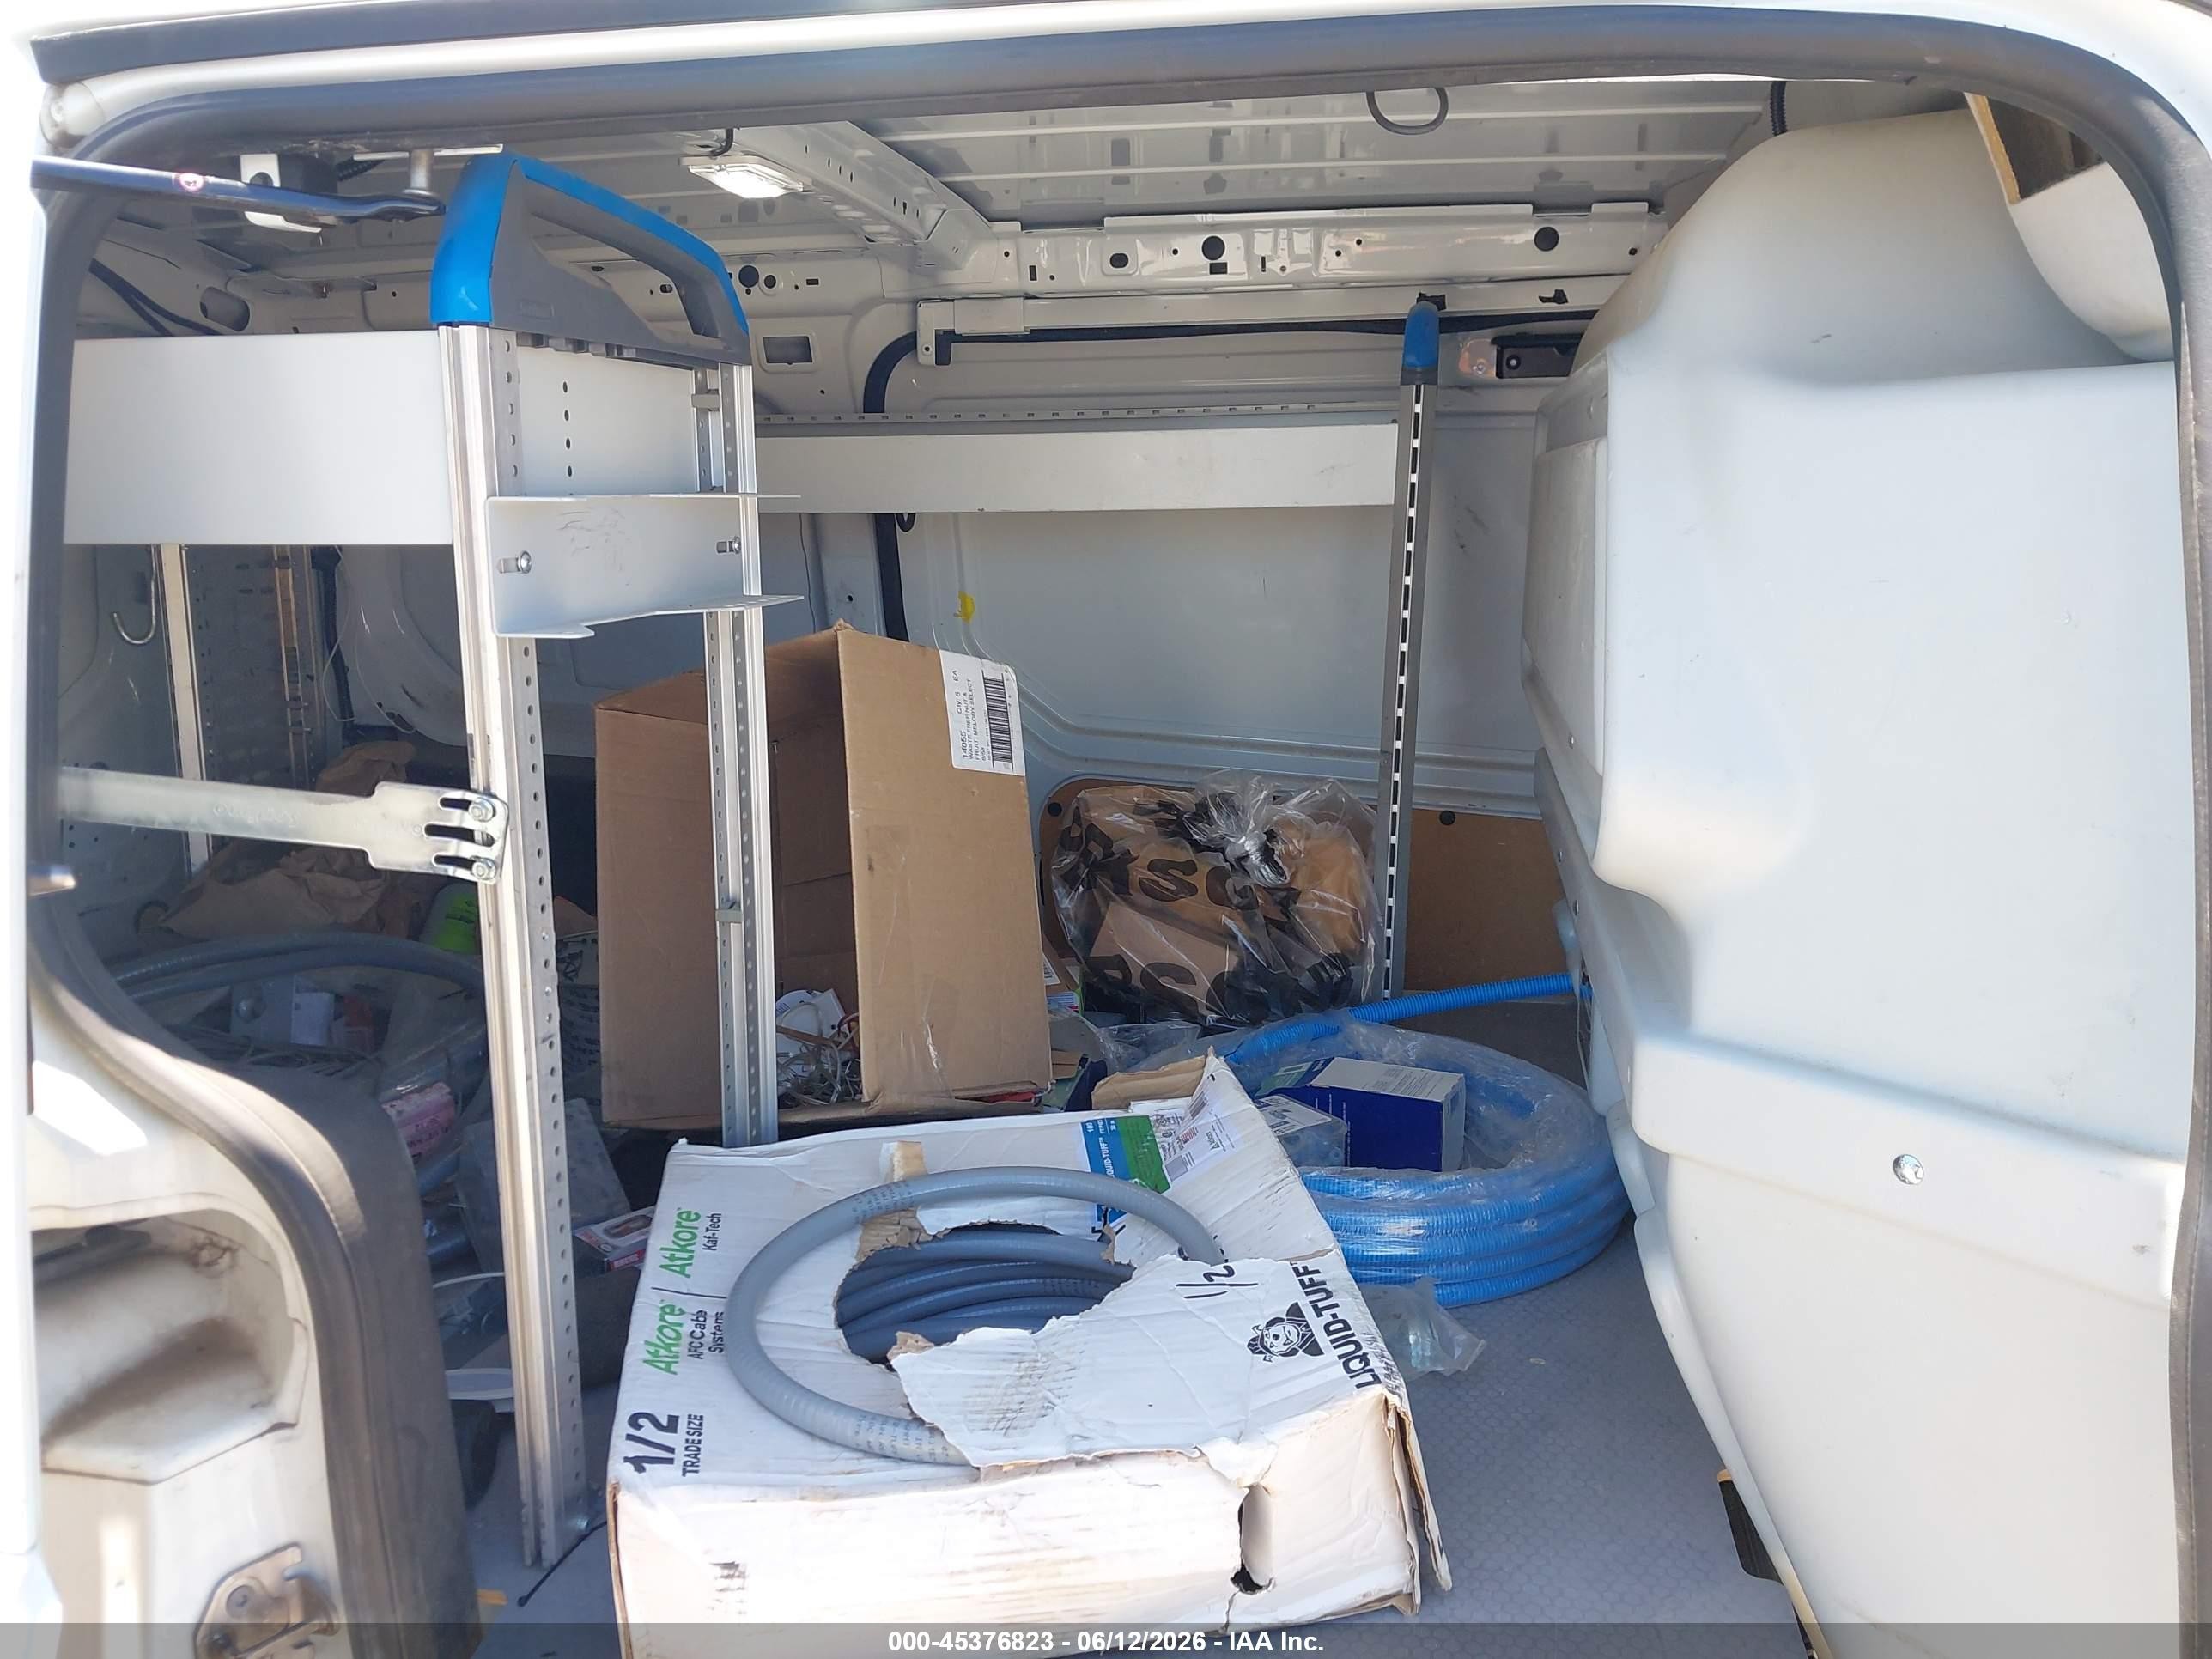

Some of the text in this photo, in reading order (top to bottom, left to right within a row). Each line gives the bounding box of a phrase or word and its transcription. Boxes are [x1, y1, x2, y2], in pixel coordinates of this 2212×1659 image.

[952, 670, 959, 682] EA
[659, 1209, 701, 1279] Atkore
[702, 1212, 722, 1251] Kaf-Tech
[643, 1302, 687, 1376] Atkore
[687, 1340, 704, 1360] AFC
[623, 1412, 680, 1474] 1/2
[682, 1413, 704, 1478] TRADE SIZE
